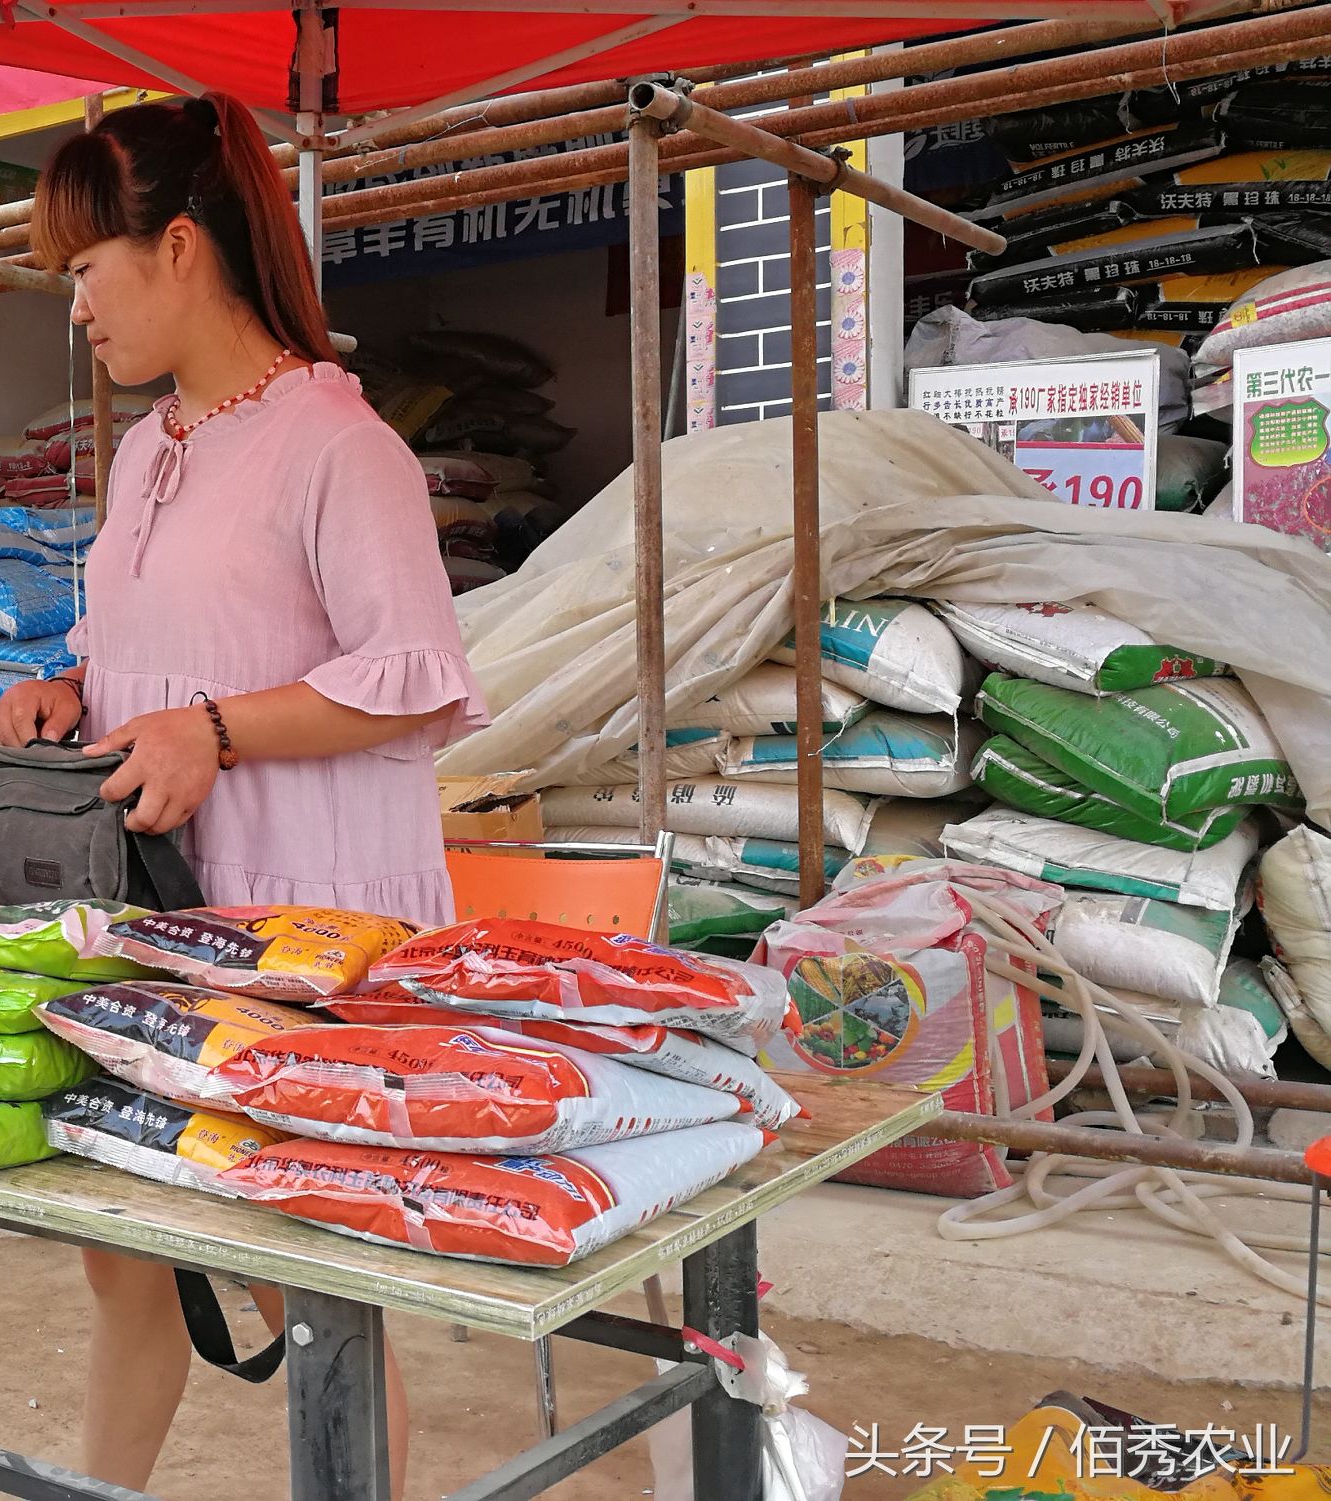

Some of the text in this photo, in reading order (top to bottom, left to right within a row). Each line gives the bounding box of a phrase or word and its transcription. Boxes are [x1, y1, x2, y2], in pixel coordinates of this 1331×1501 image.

[1115, 136, 1166, 162] 沃夫特
[1002, 172, 1045, 191] 18-18-18
[1161, 193, 1212, 210] 沃夫特
[1223, 190, 1280, 206] 黑珍珠
[1023, 253, 1192, 293] 沃夫特 黑珍珠 18-18-18
[1145, 310, 1190, 323] 18-18-18
[142, 918, 254, 959] 中美合资 登海先锋
[82, 993, 137, 1019] 中美合资
[236, 1007, 285, 1031] 4000
[64, 1092, 168, 1130] 中美合资 登海先锋
